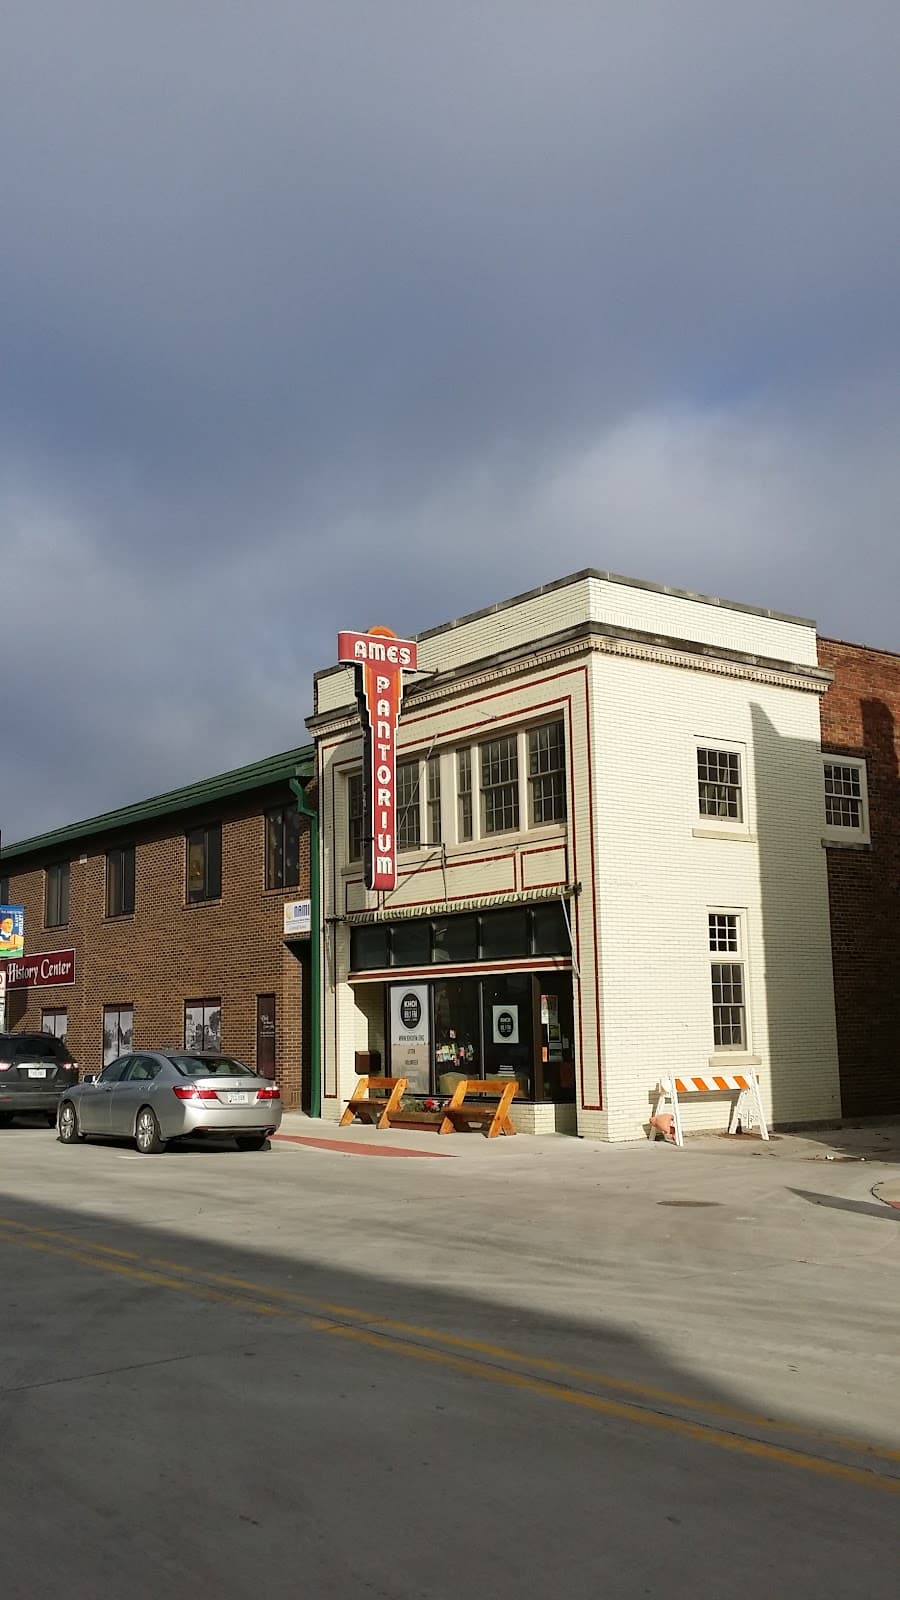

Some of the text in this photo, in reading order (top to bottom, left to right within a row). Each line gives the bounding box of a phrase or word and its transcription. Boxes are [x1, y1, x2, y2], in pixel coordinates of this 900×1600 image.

[354, 640, 411, 665] AMES
[376, 676, 393, 875] PANTORIUM
[7, 962, 39, 985] History
[41, 958, 72, 979] Center
